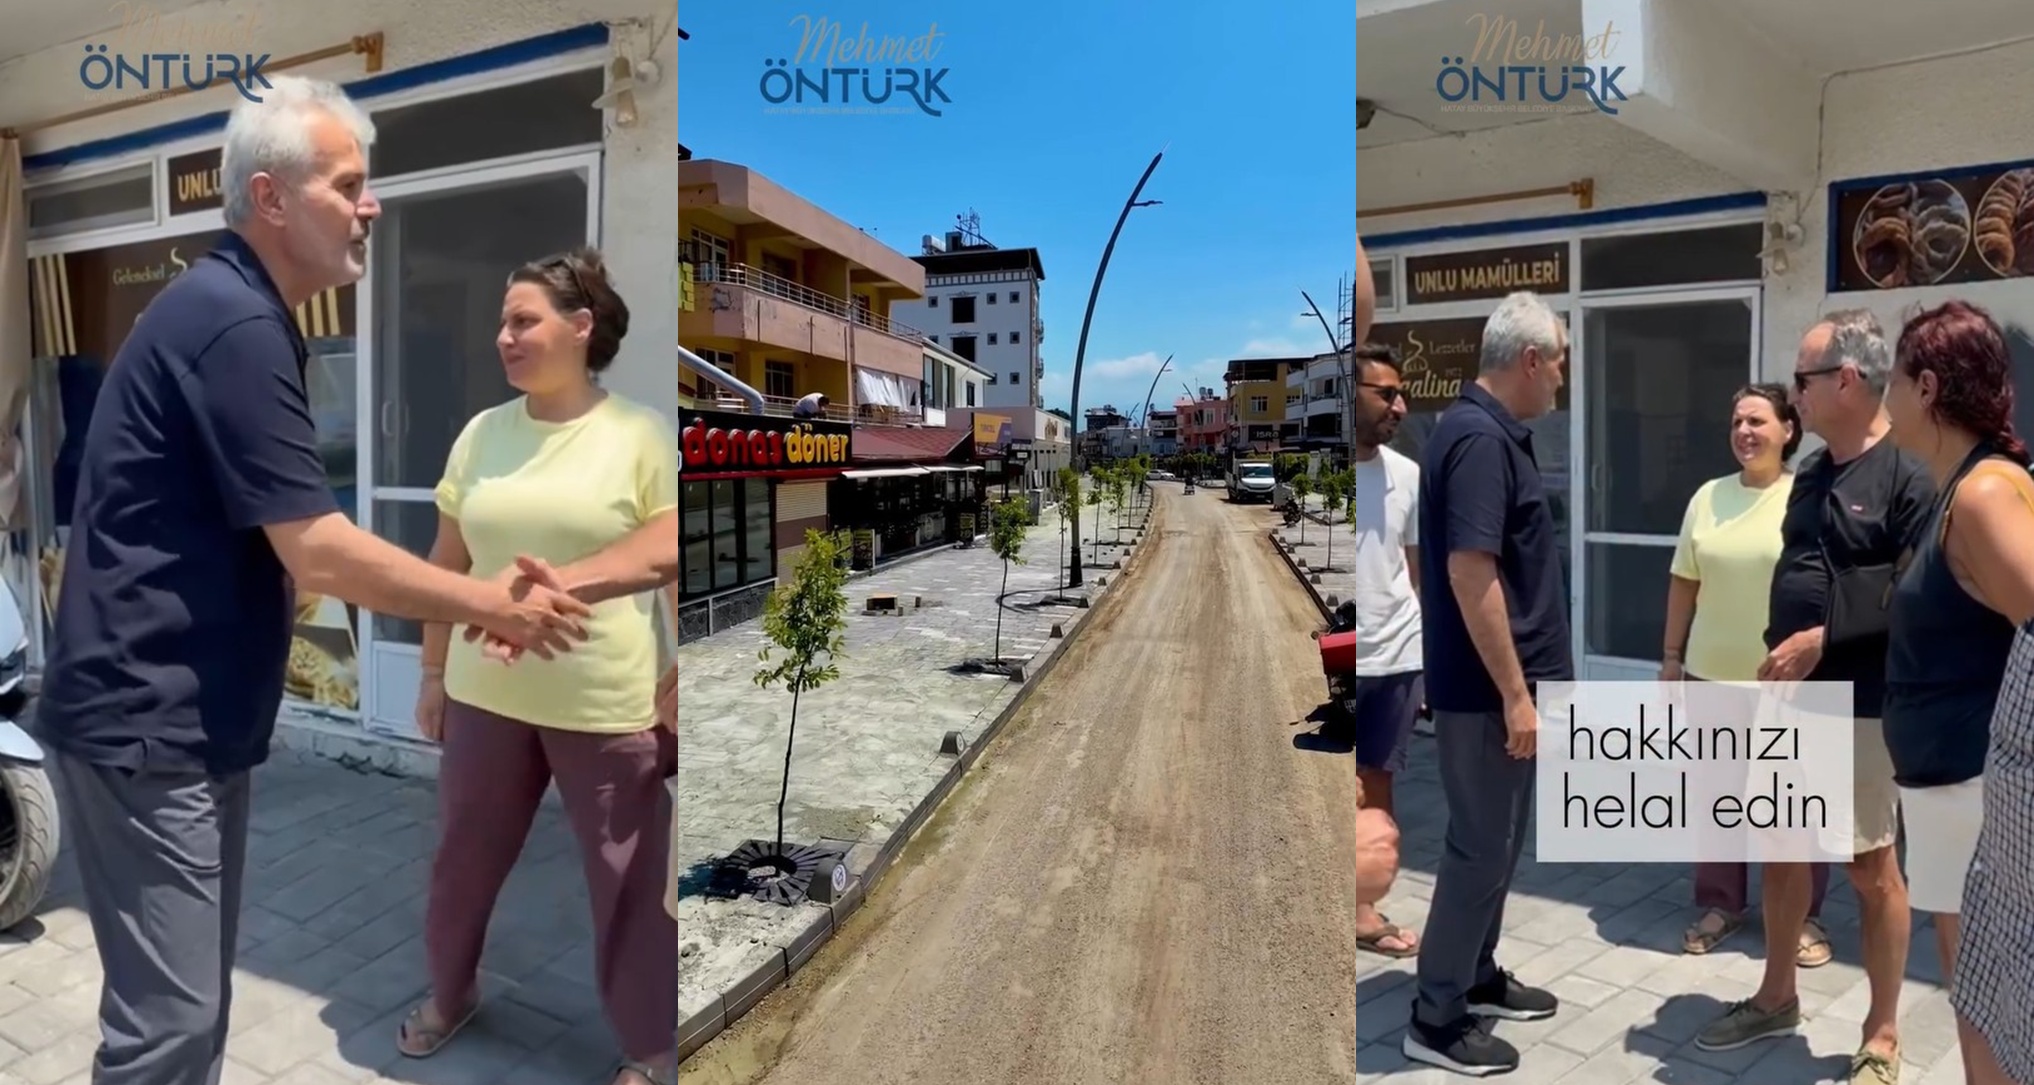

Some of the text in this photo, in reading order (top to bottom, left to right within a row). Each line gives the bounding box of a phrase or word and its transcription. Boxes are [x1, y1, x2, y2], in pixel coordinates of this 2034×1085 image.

[177, 168, 222, 202] UNLU
[1415, 252, 1560, 293] UNLU MAMÜLLERİ
[682, 417, 849, 467] donas döner
